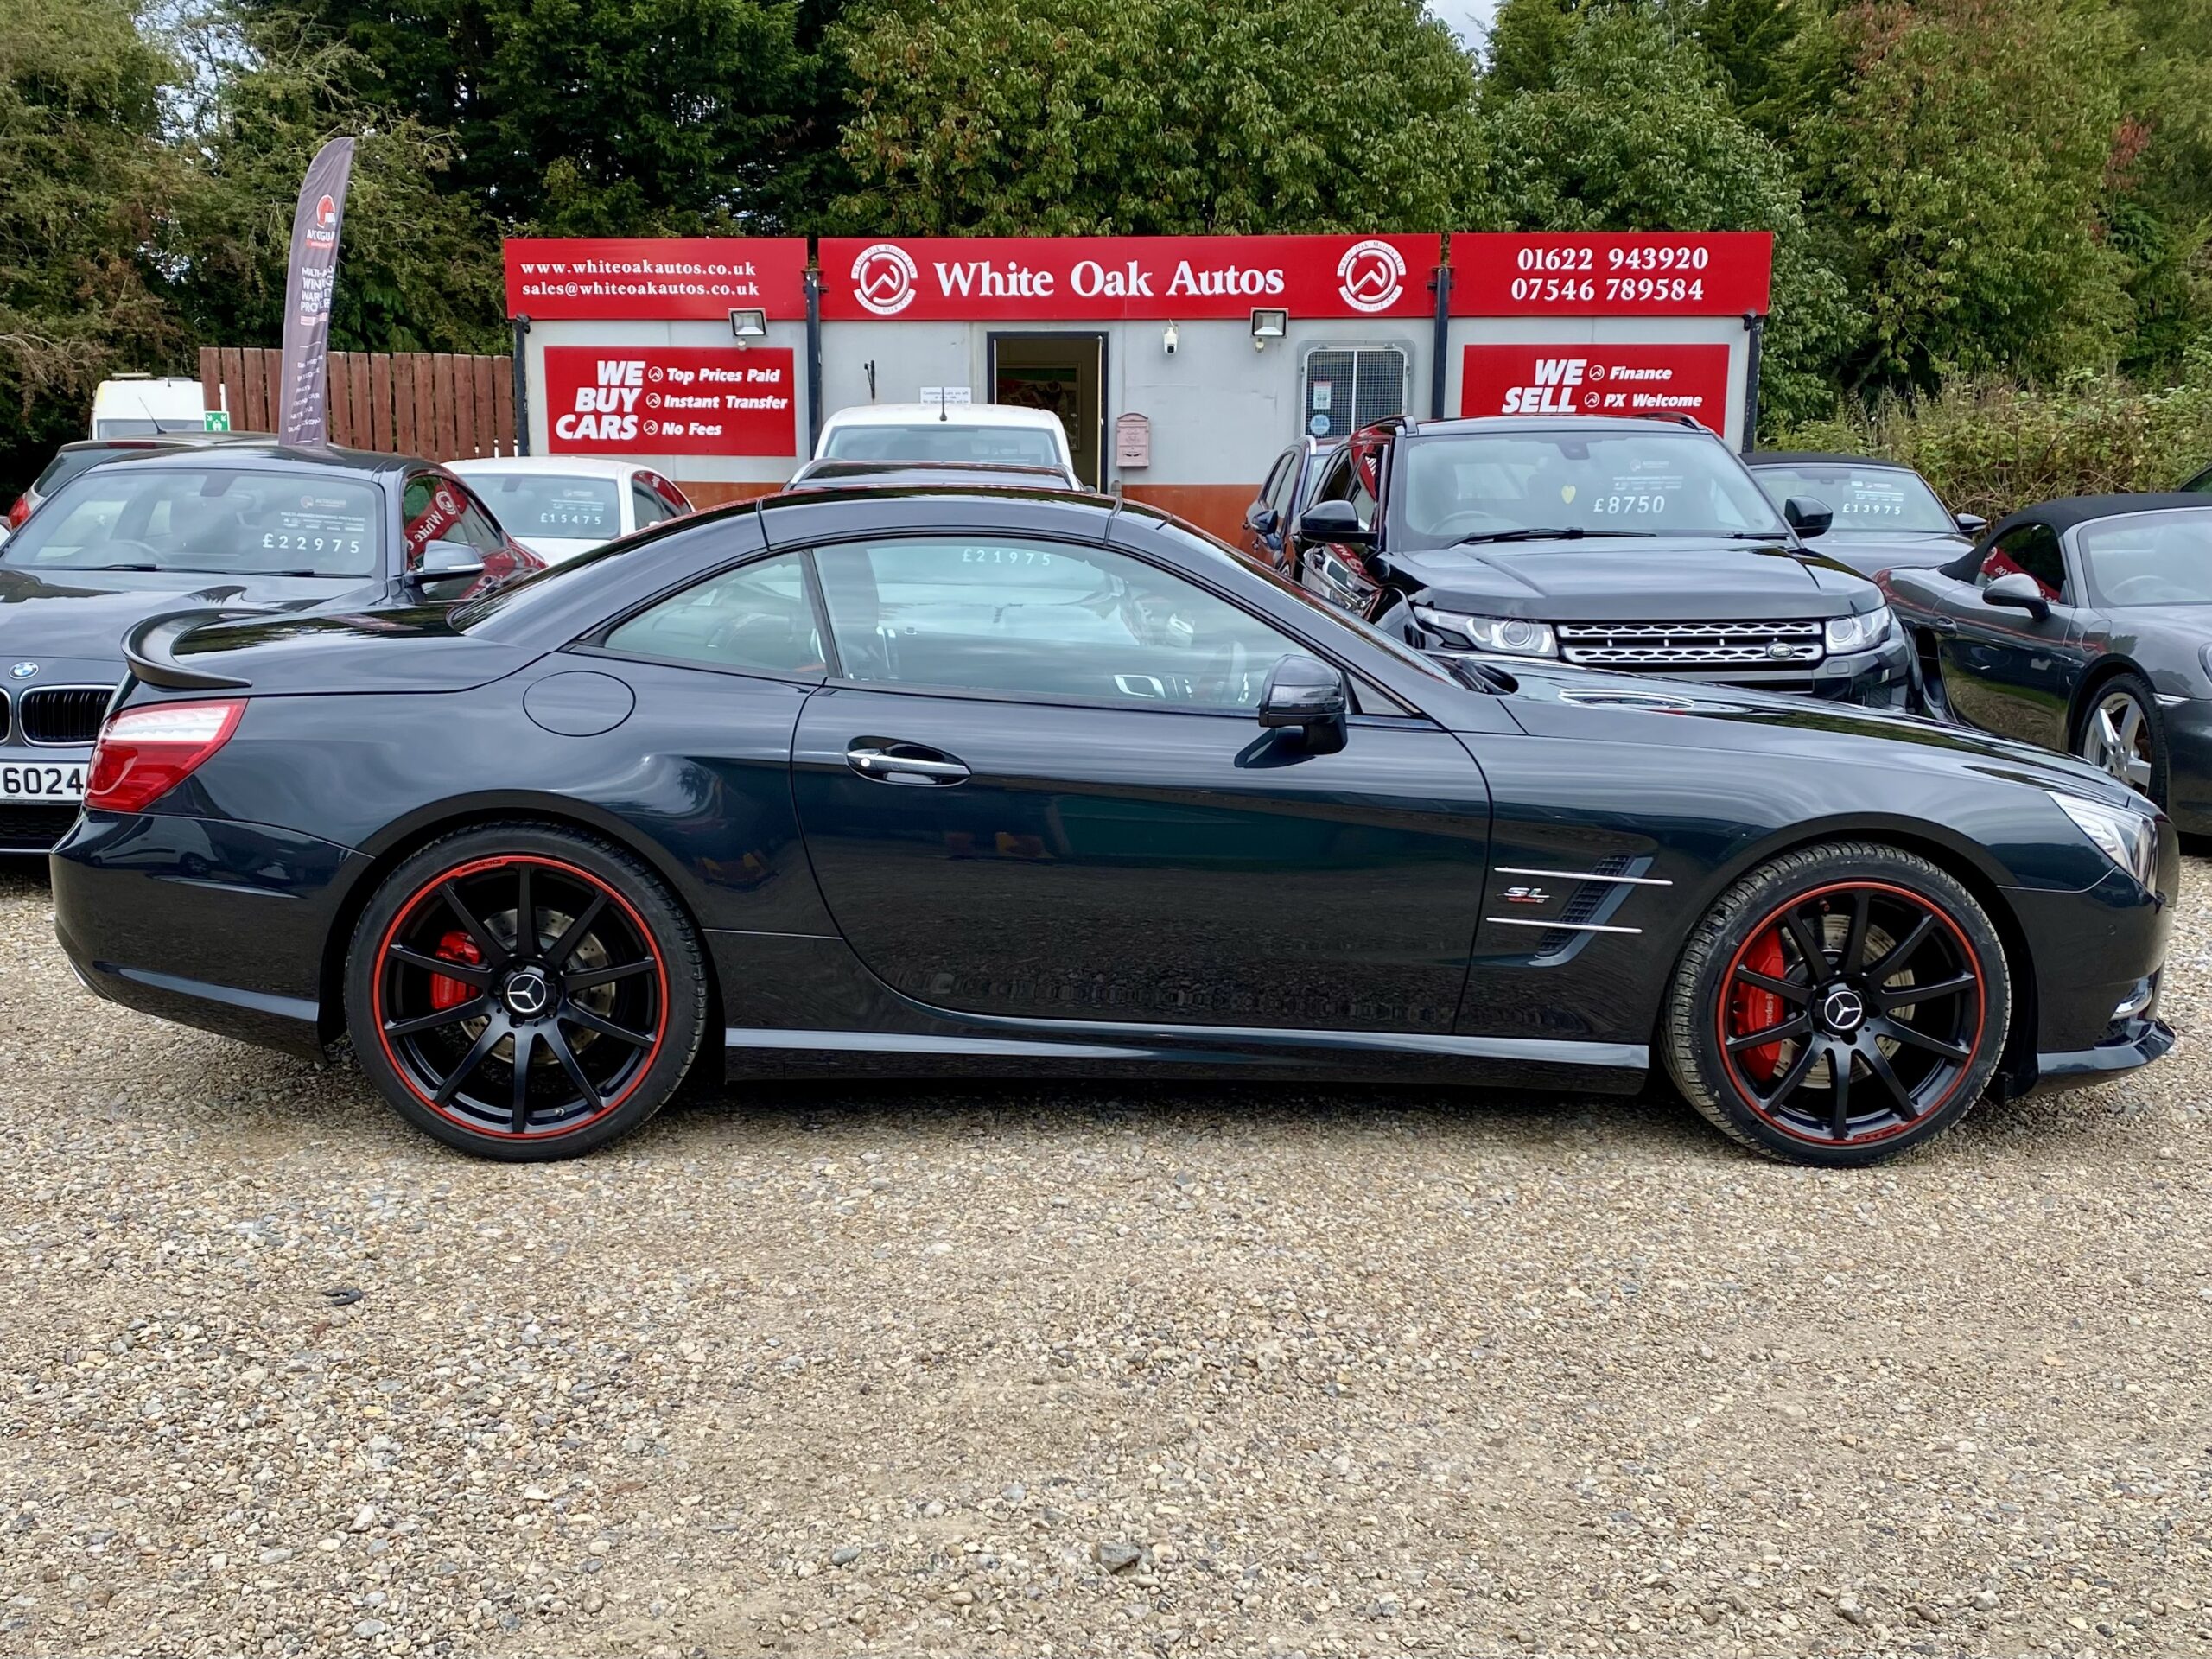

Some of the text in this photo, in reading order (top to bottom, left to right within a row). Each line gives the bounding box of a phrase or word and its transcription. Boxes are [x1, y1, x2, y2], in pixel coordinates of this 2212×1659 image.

[520, 258, 756, 276] www.whiteoakautos.co.uk
[1517, 247, 1709, 270] 01622 943920
[932, 259, 1285, 297] White Oak Autos
[522, 281, 760, 297] sales@whiteoakautos.co.uk
[1511, 277, 1704, 302] 07546 789584
[597, 360, 646, 386] WE
[666, 367, 781, 385] Top Prices Paid
[1535, 359, 1587, 385] WE
[1609, 365, 1673, 380] Finance
[574, 387, 643, 413] BUY
[664, 394, 788, 410] Instant Transfer
[1501, 386, 1577, 414] SELL
[1603, 393, 1703, 408] PX Welcome
[555, 414, 639, 441] CARS
[661, 422, 722, 436] No Fees
[1593, 495, 1665, 514] £8750
[1842, 503, 1901, 515] £13975
[540, 512, 601, 525] £15475
[262, 532, 359, 553] £22975
[962, 548, 1050, 566] £21975
[3, 767, 84, 794] 6024
[1503, 887, 1550, 898] SL
